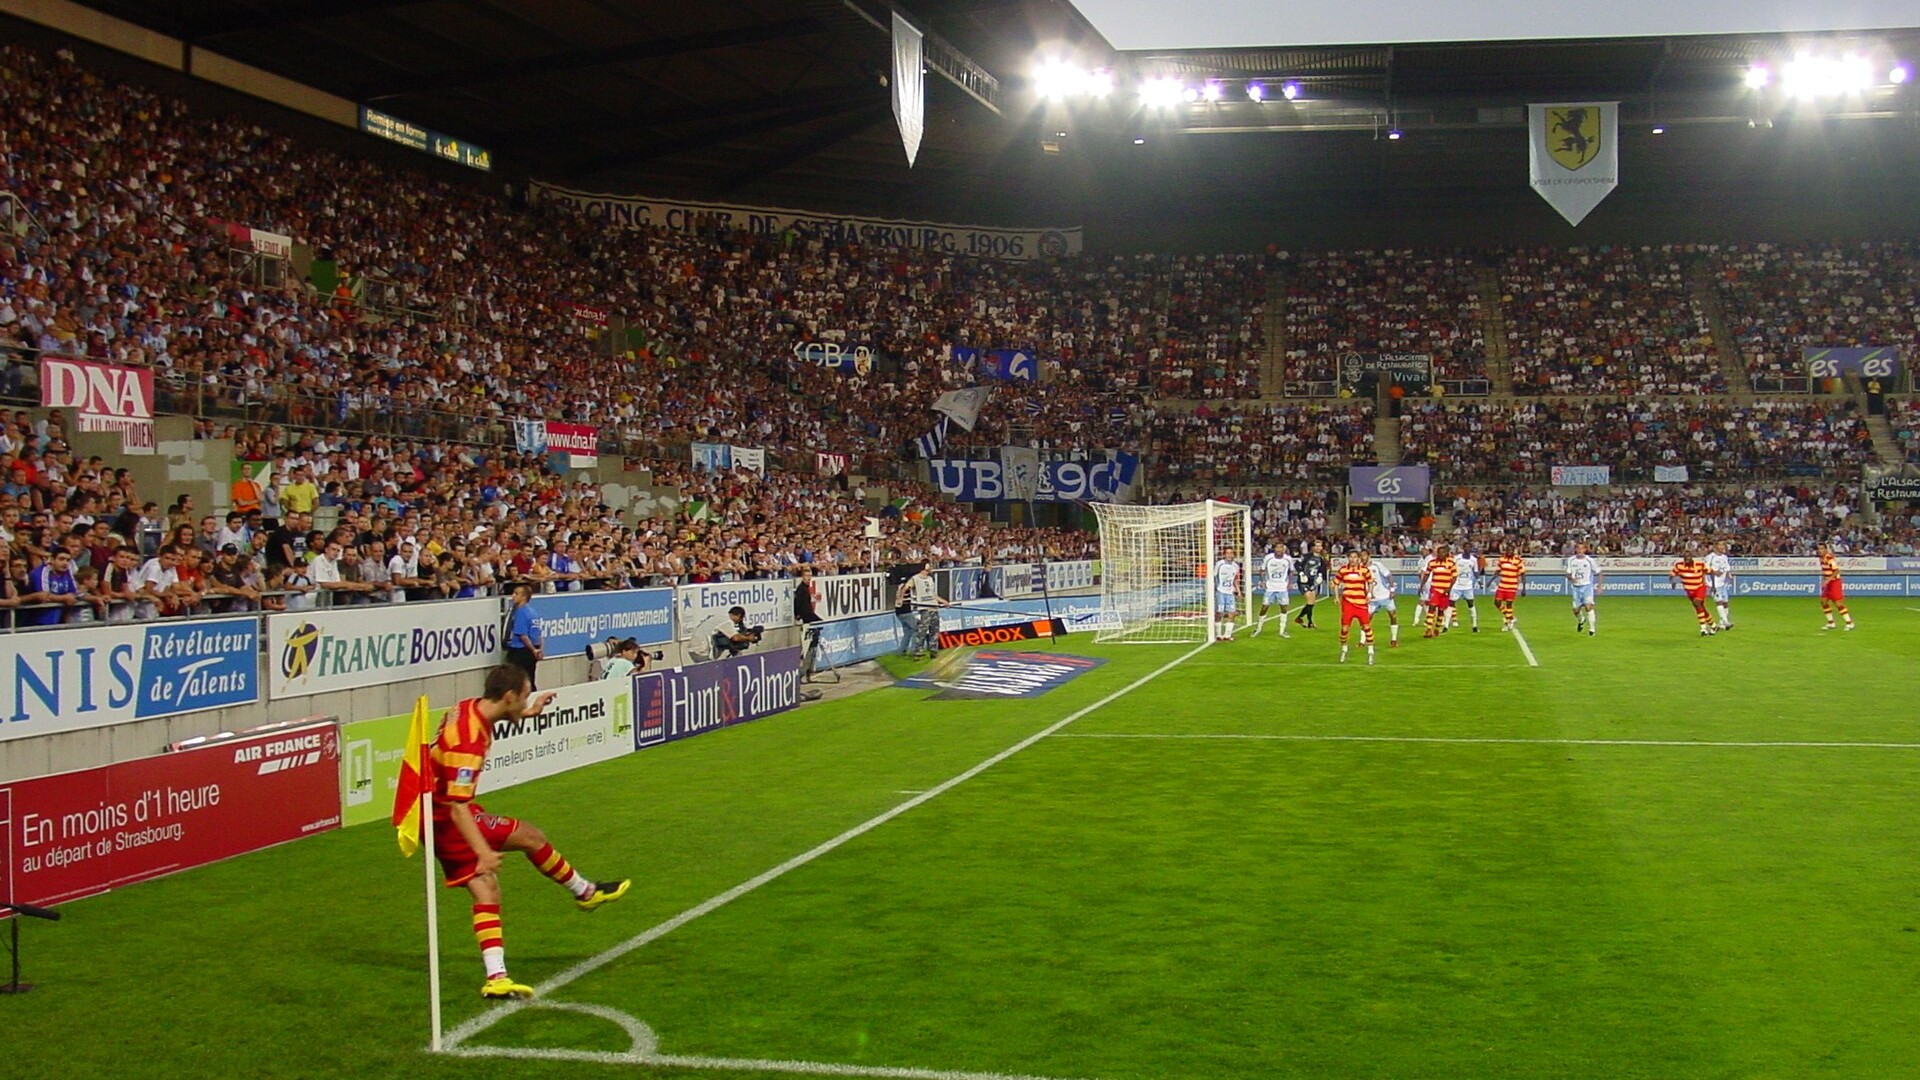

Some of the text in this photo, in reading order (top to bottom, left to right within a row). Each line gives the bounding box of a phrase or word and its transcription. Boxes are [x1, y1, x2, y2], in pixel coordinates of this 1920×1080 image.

[46, 361, 151, 419] DNA
[701, 584, 778, 609] Ensemble,
[825, 577, 882, 616] WÜRTH
[1752, 581, 1815, 593] Strasbourg
[539, 612, 598, 638] trasbourg
[599, 614, 611, 631] en
[612, 606, 669, 629] mouvement
[939, 626, 1025, 649] livebox
[149, 631, 252, 660] Révélateur
[317, 624, 496, 677] FRANCE BOISSONS
[0, 644, 134, 724] NIS
[151, 657, 246, 706] de Talents
[671, 663, 800, 735] Hunt & Palmer
[234, 734, 321, 764] AIR FRANCE
[23, 783, 220, 847] En moins d'1 heure
[23, 821, 185, 874] au départ de Strasbourg.
